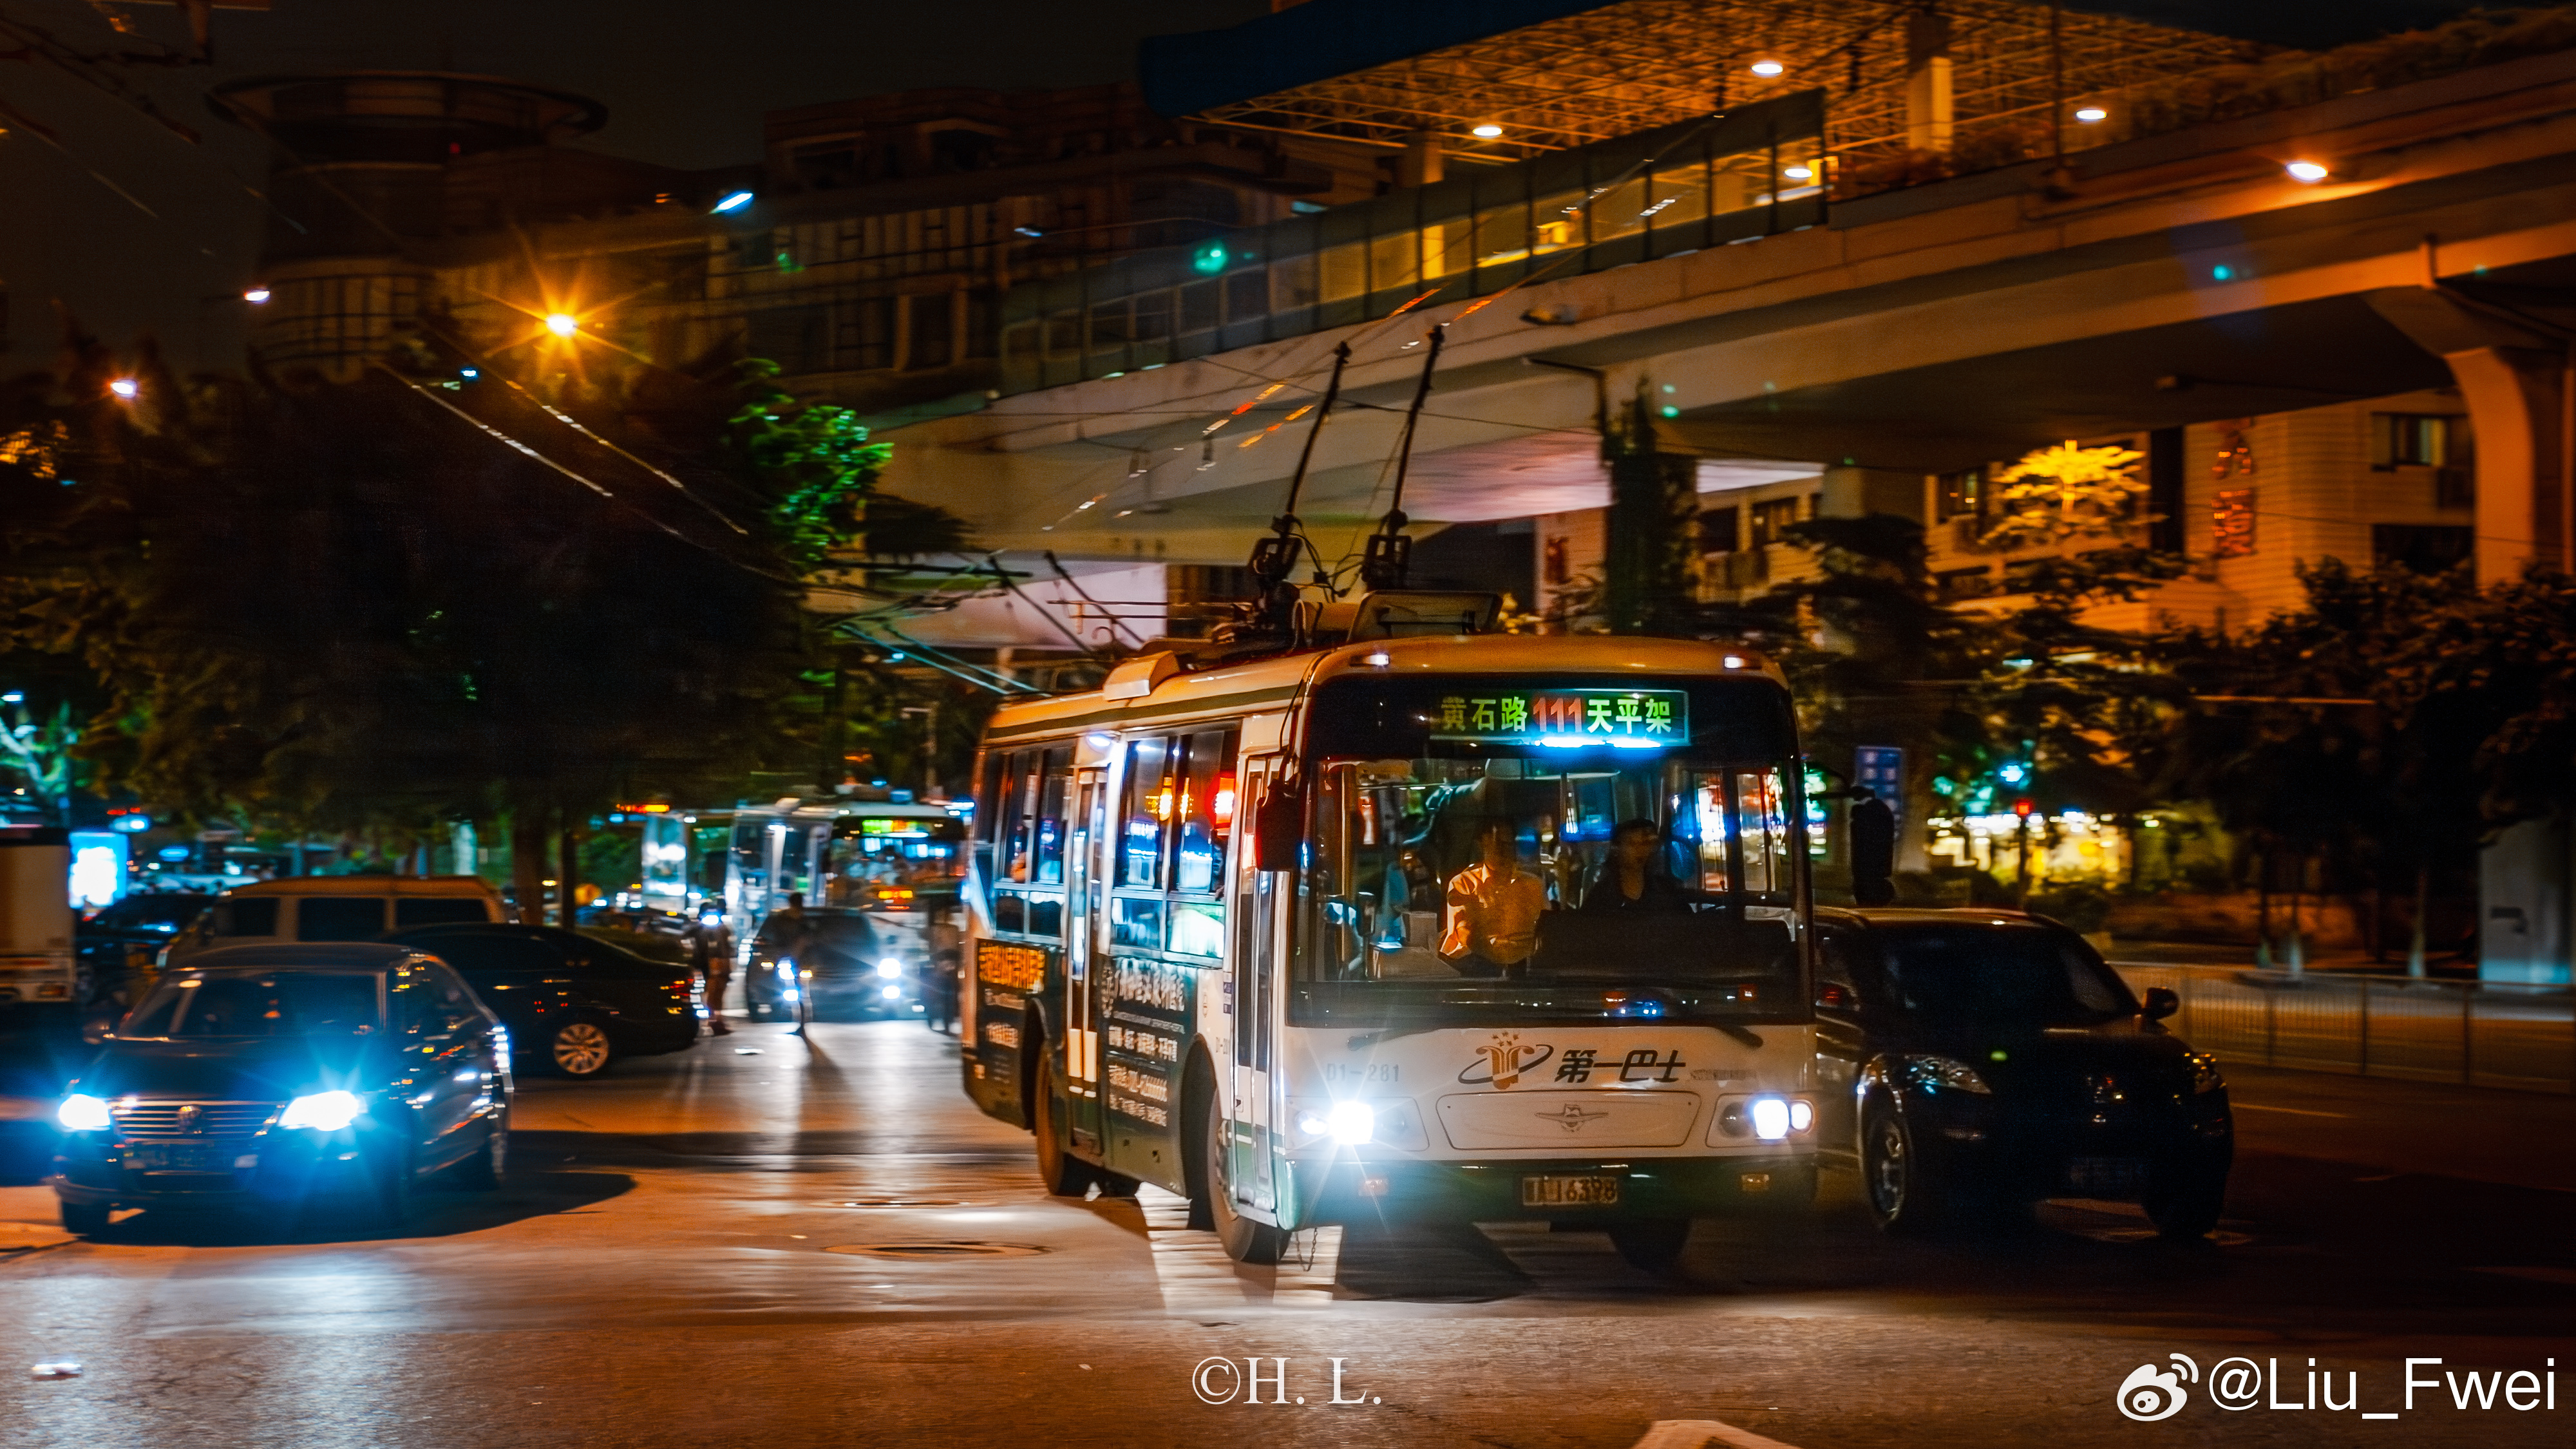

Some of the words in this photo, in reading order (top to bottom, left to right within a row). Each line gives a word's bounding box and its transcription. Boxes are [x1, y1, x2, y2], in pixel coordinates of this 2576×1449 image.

[1441, 696, 1528, 732] 黄石路
[1533, 697, 1583, 733] 111
[1587, 698, 1672, 734] 天平架
[1554, 1049, 1687, 1083] 第一巴士
